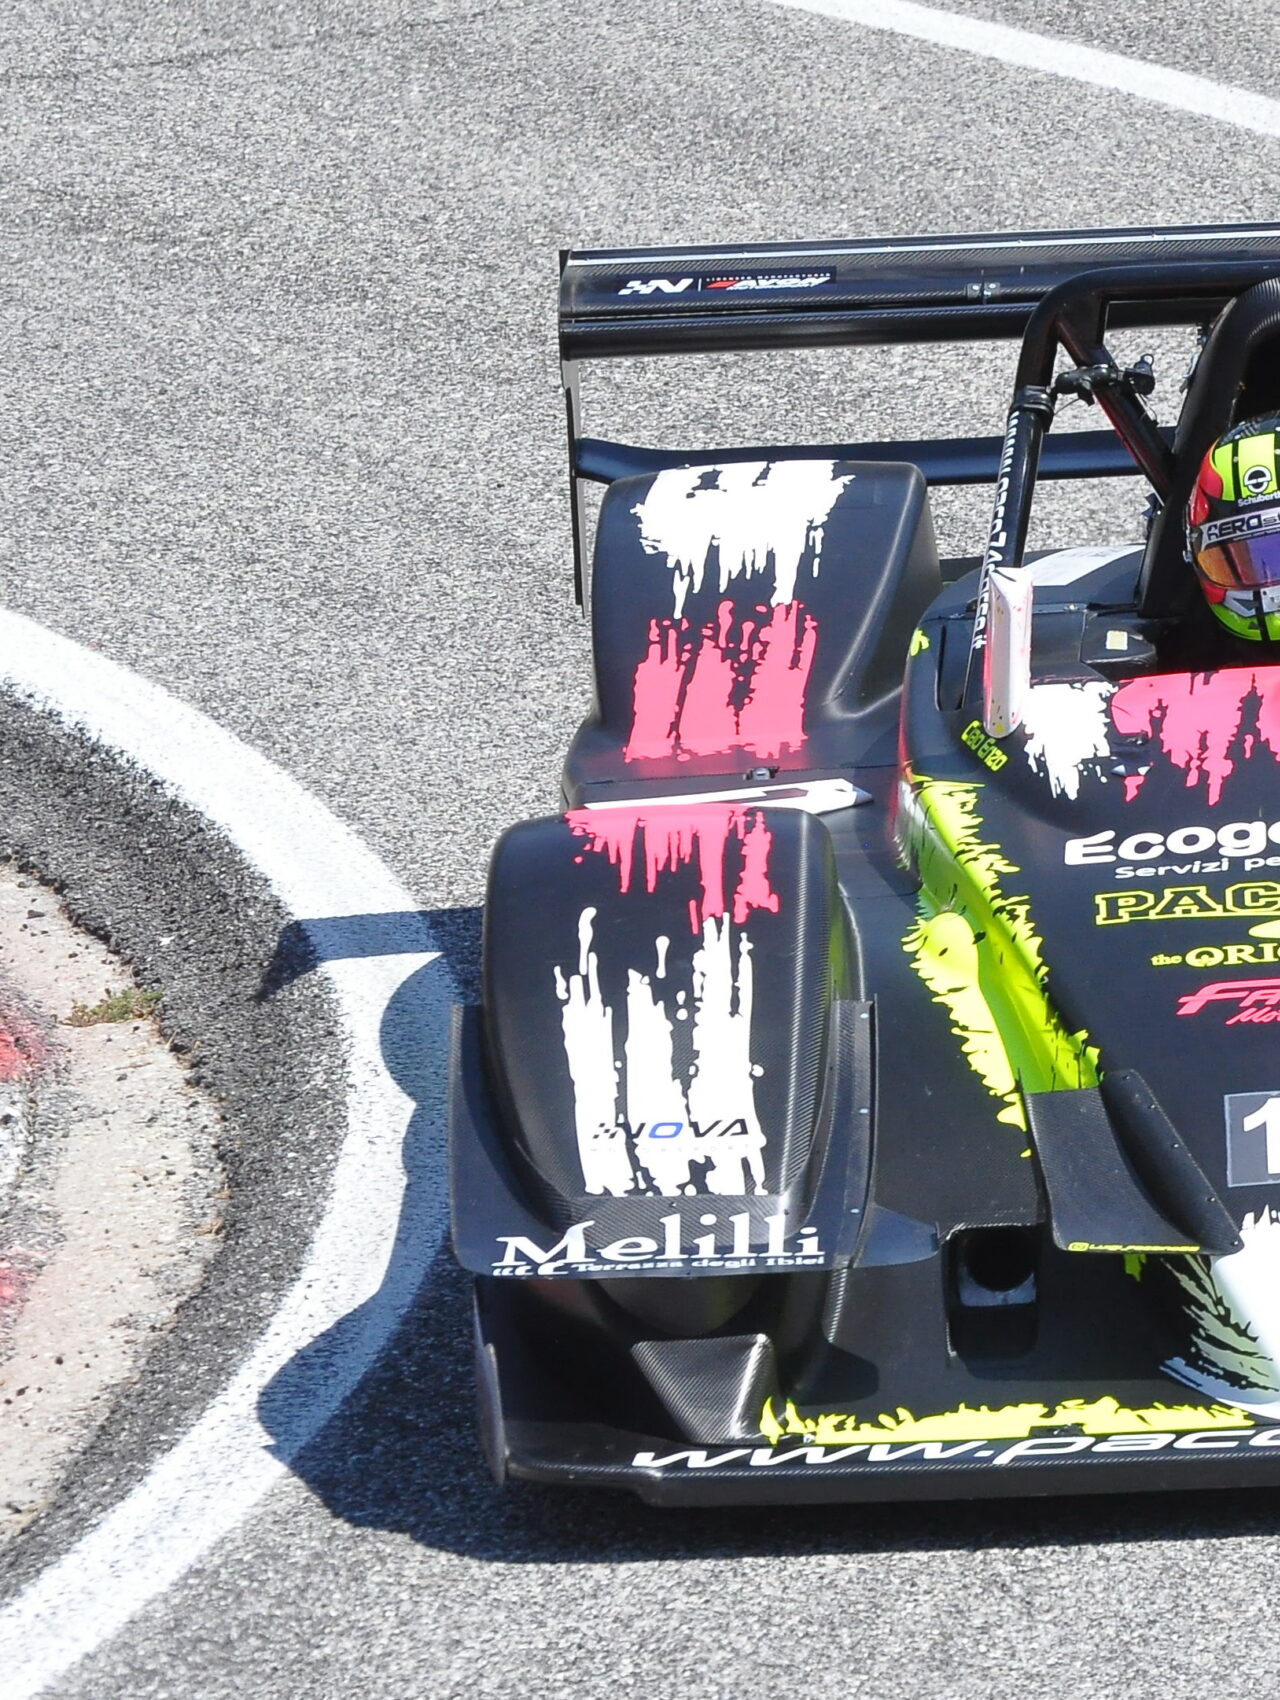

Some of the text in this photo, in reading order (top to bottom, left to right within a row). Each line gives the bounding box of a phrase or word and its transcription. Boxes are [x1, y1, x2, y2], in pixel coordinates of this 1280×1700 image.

[1115, 858, 1229, 879] Servizi
[1151, 953, 1182, 967] the
[606, 1118, 749, 1139] NOVA
[491, 1212, 826, 1266] Melilli
[571, 1255, 825, 1272] Terrazza degli Iblei
